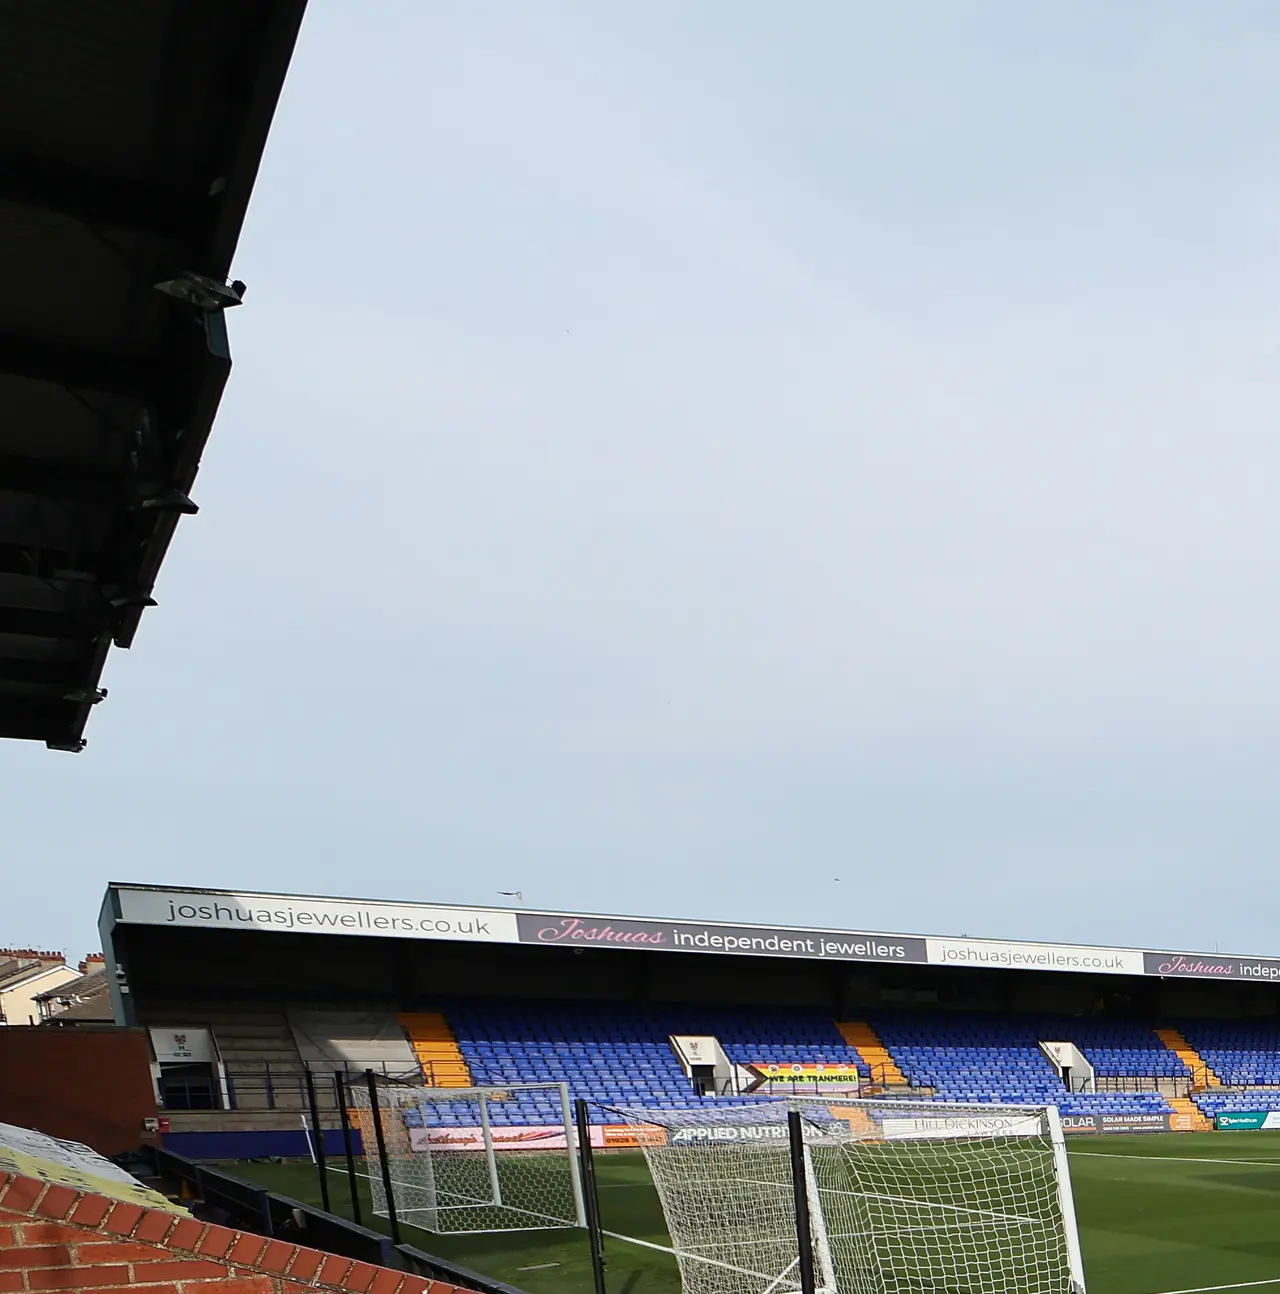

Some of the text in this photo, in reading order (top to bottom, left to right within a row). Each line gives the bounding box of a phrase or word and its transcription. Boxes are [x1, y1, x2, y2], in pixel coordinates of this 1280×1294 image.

[167, 899, 491, 936] joshuasjewellers.co.uk
[537, 918, 905, 958] Joshuas independent jewellers
[940, 945, 1124, 970] joshuasjewellers.co.uk
[1158, 955, 1234, 976] Joshuas
[672, 1127, 738, 1141] APPLIED
[740, 1124, 822, 1139] NUTRION
[914, 1118, 1012, 1130] HILL DICKINSON
